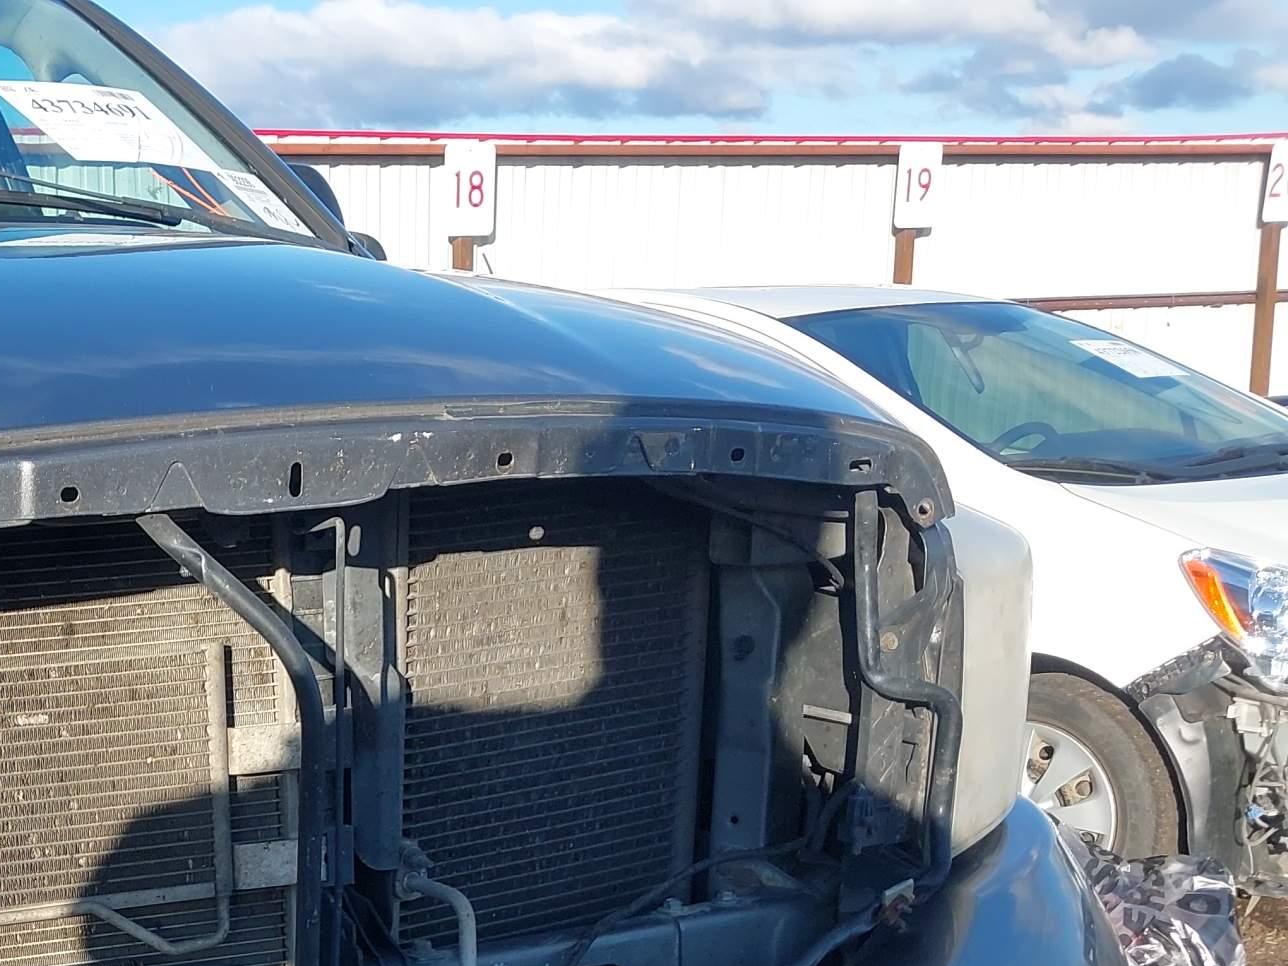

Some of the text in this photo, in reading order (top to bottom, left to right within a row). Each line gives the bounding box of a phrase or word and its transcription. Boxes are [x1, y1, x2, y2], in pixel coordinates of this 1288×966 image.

[31, 99, 152, 120] 43734691
[455, 170, 484, 208] 18
[905, 167, 932, 202] 19
[1268, 163, 1288, 198] 2
